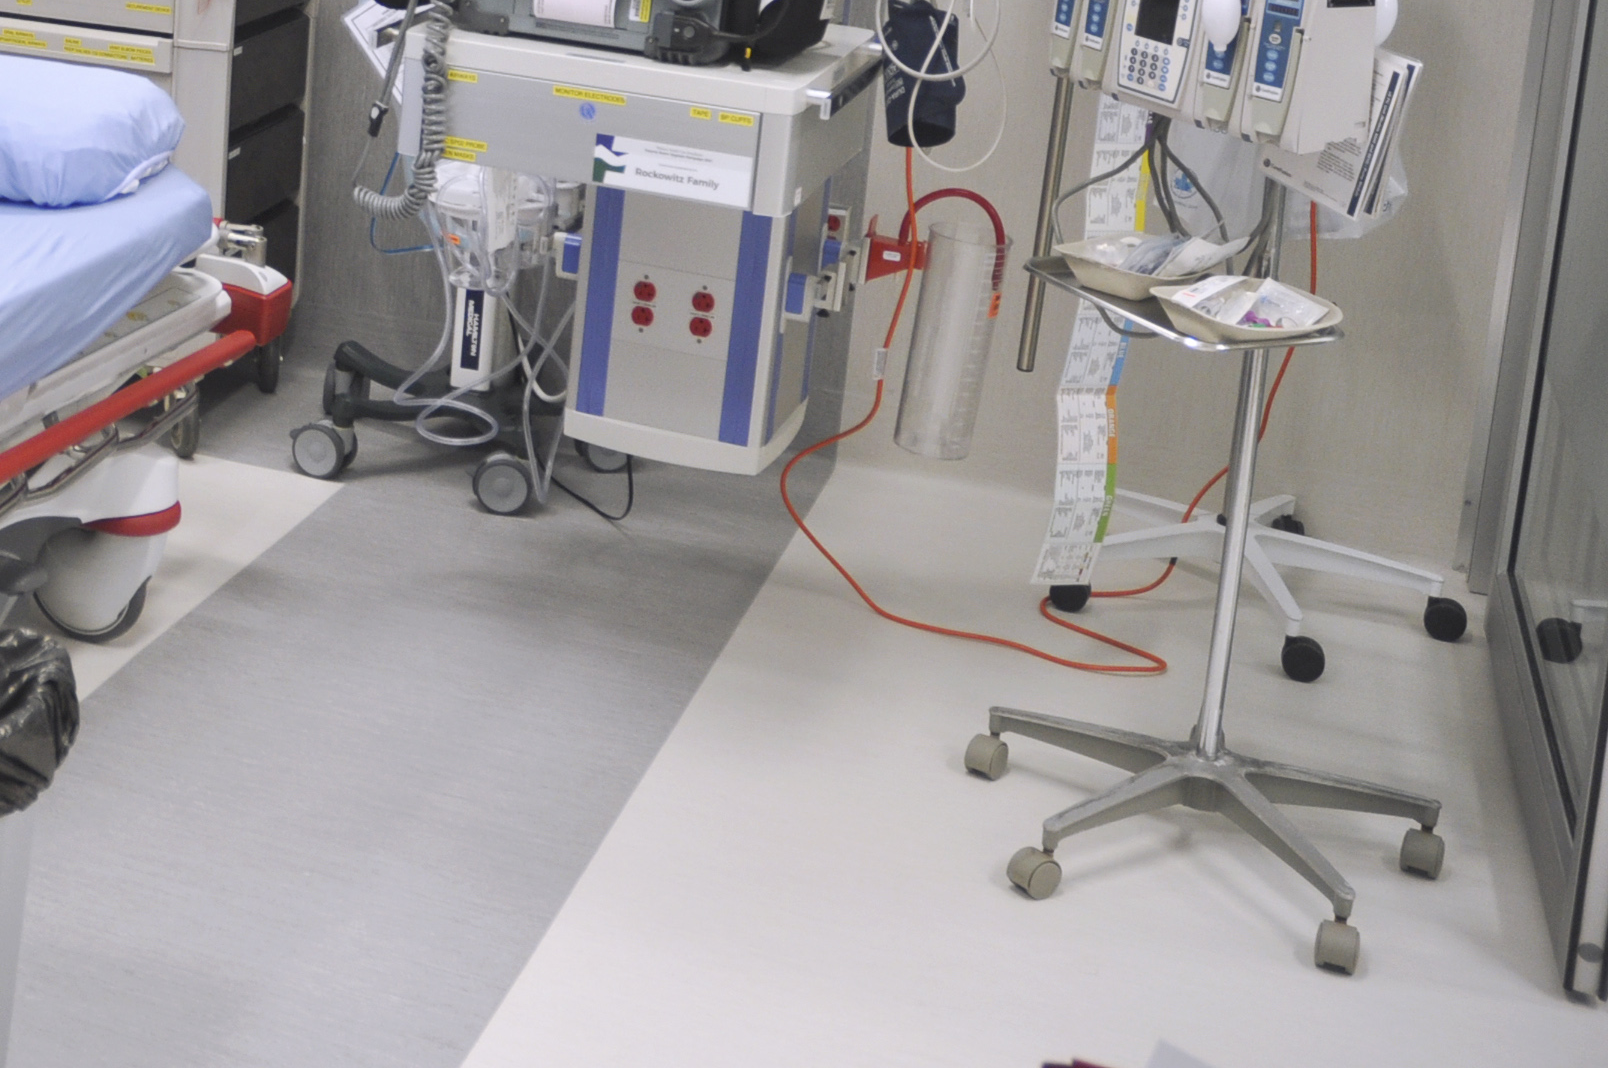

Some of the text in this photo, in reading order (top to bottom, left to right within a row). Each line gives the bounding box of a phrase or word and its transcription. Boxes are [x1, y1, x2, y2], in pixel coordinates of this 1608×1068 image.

[555, 87, 624, 103] MONITOR ELECTRODES
[692, 109, 709, 118] TAPE
[635, 167, 684, 184] Rockowitz
[687, 176, 720, 191] Family
[1107, 408, 1115, 438] ORANGE
